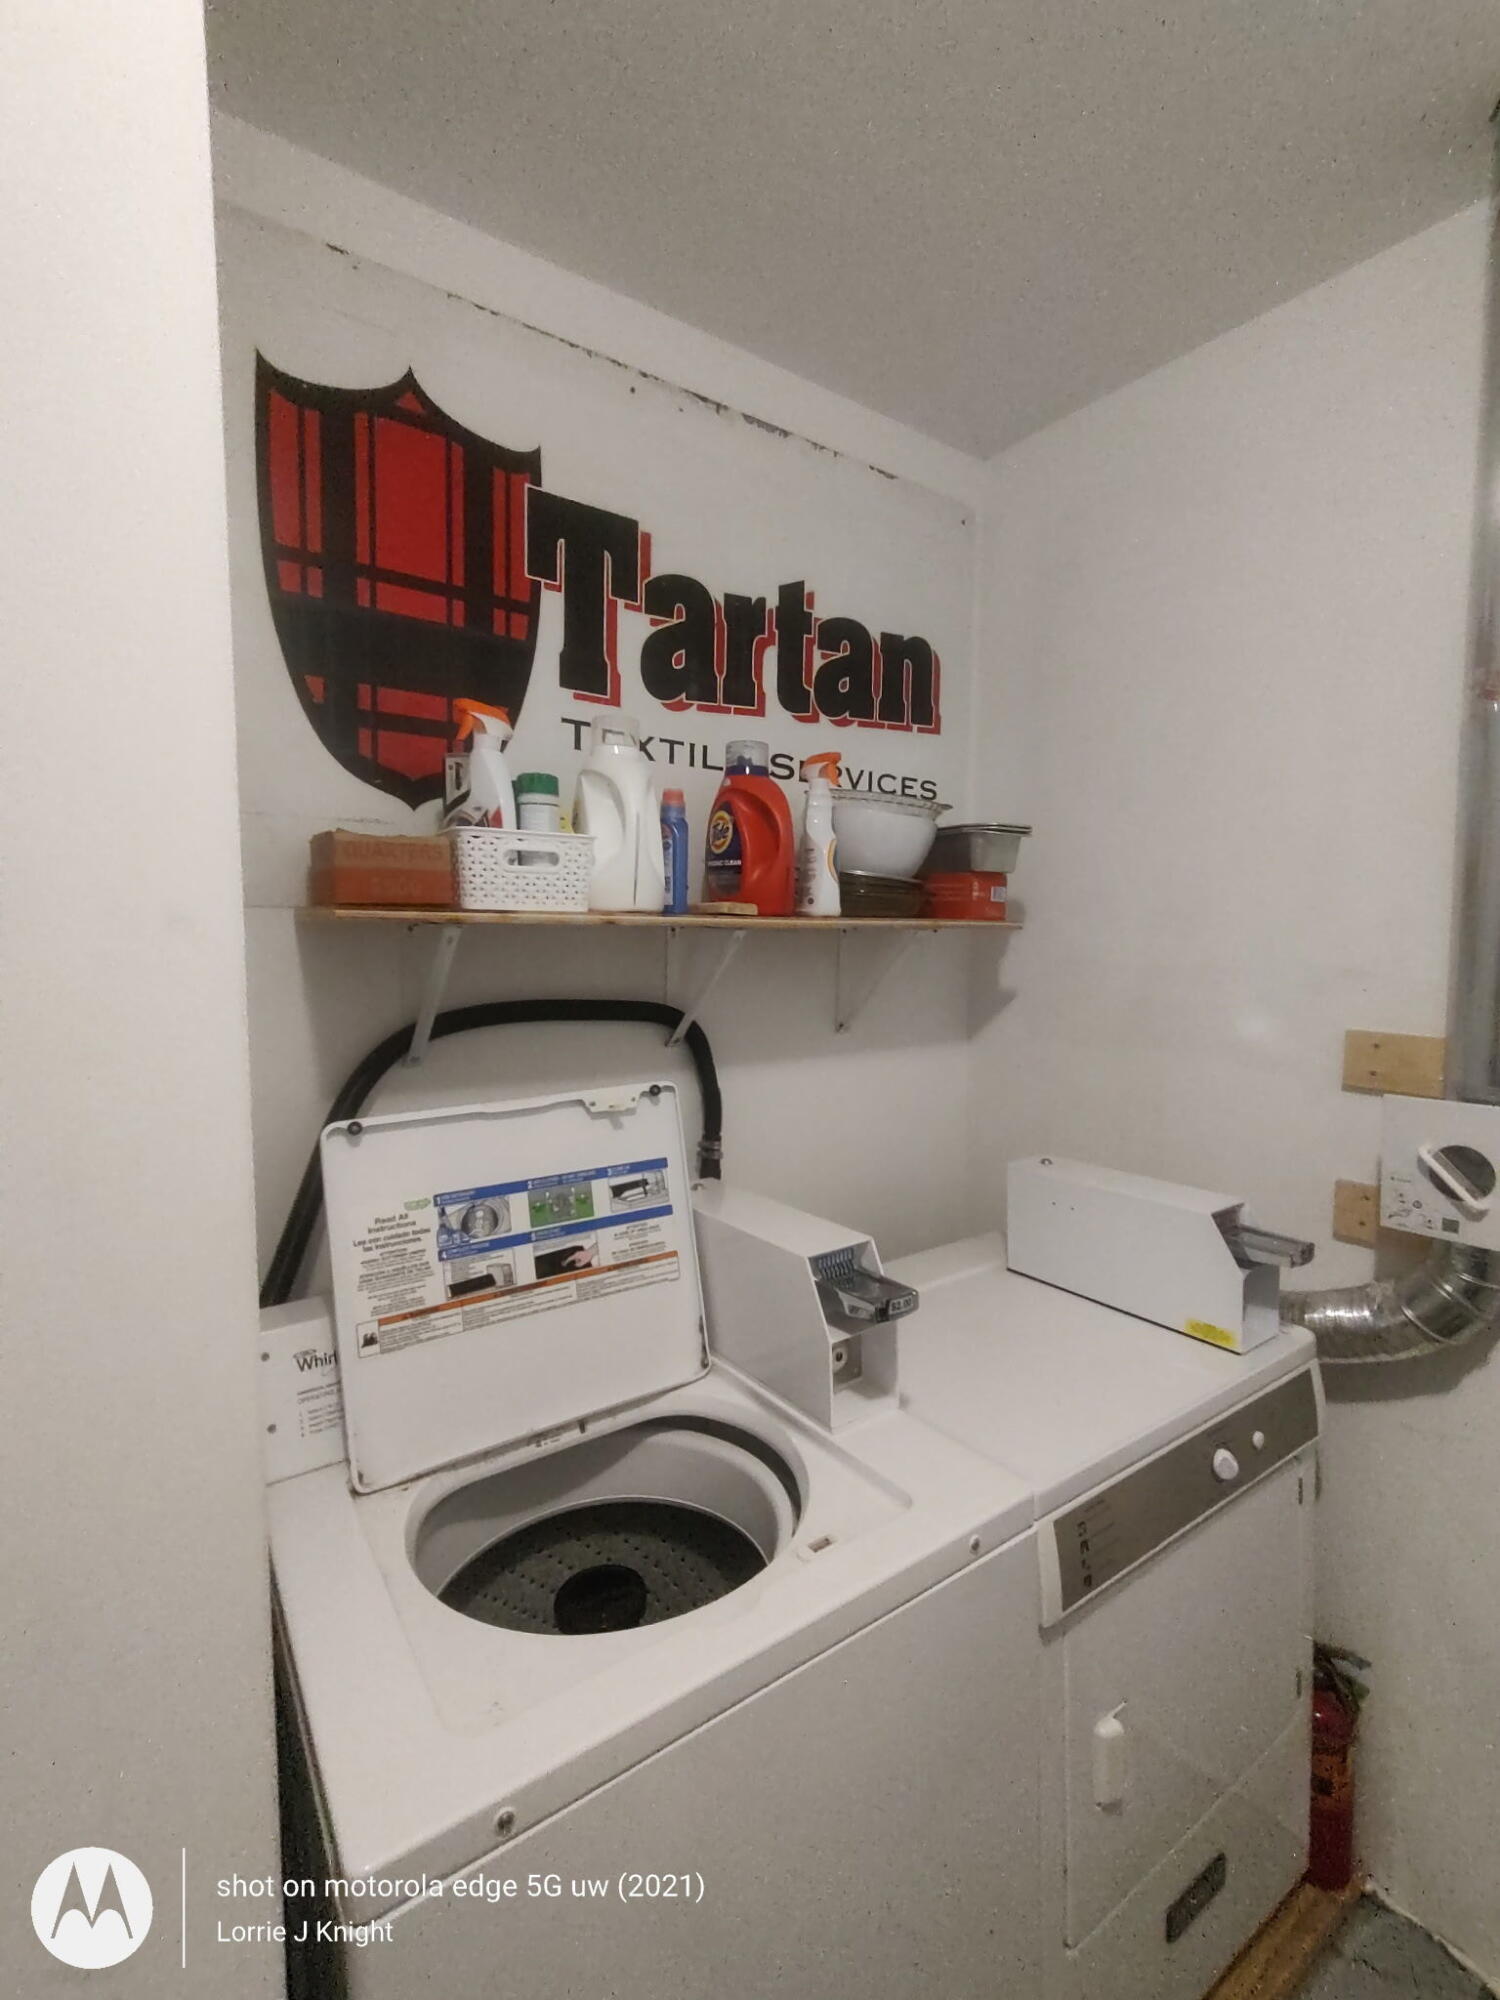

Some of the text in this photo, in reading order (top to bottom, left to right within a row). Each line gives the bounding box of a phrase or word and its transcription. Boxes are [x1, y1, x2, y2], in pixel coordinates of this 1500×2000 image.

[524, 484, 941, 735] Tartan
[561, 717, 938, 801] TXTIL SVICES
[296, 1350, 338, 1372] Whirl
